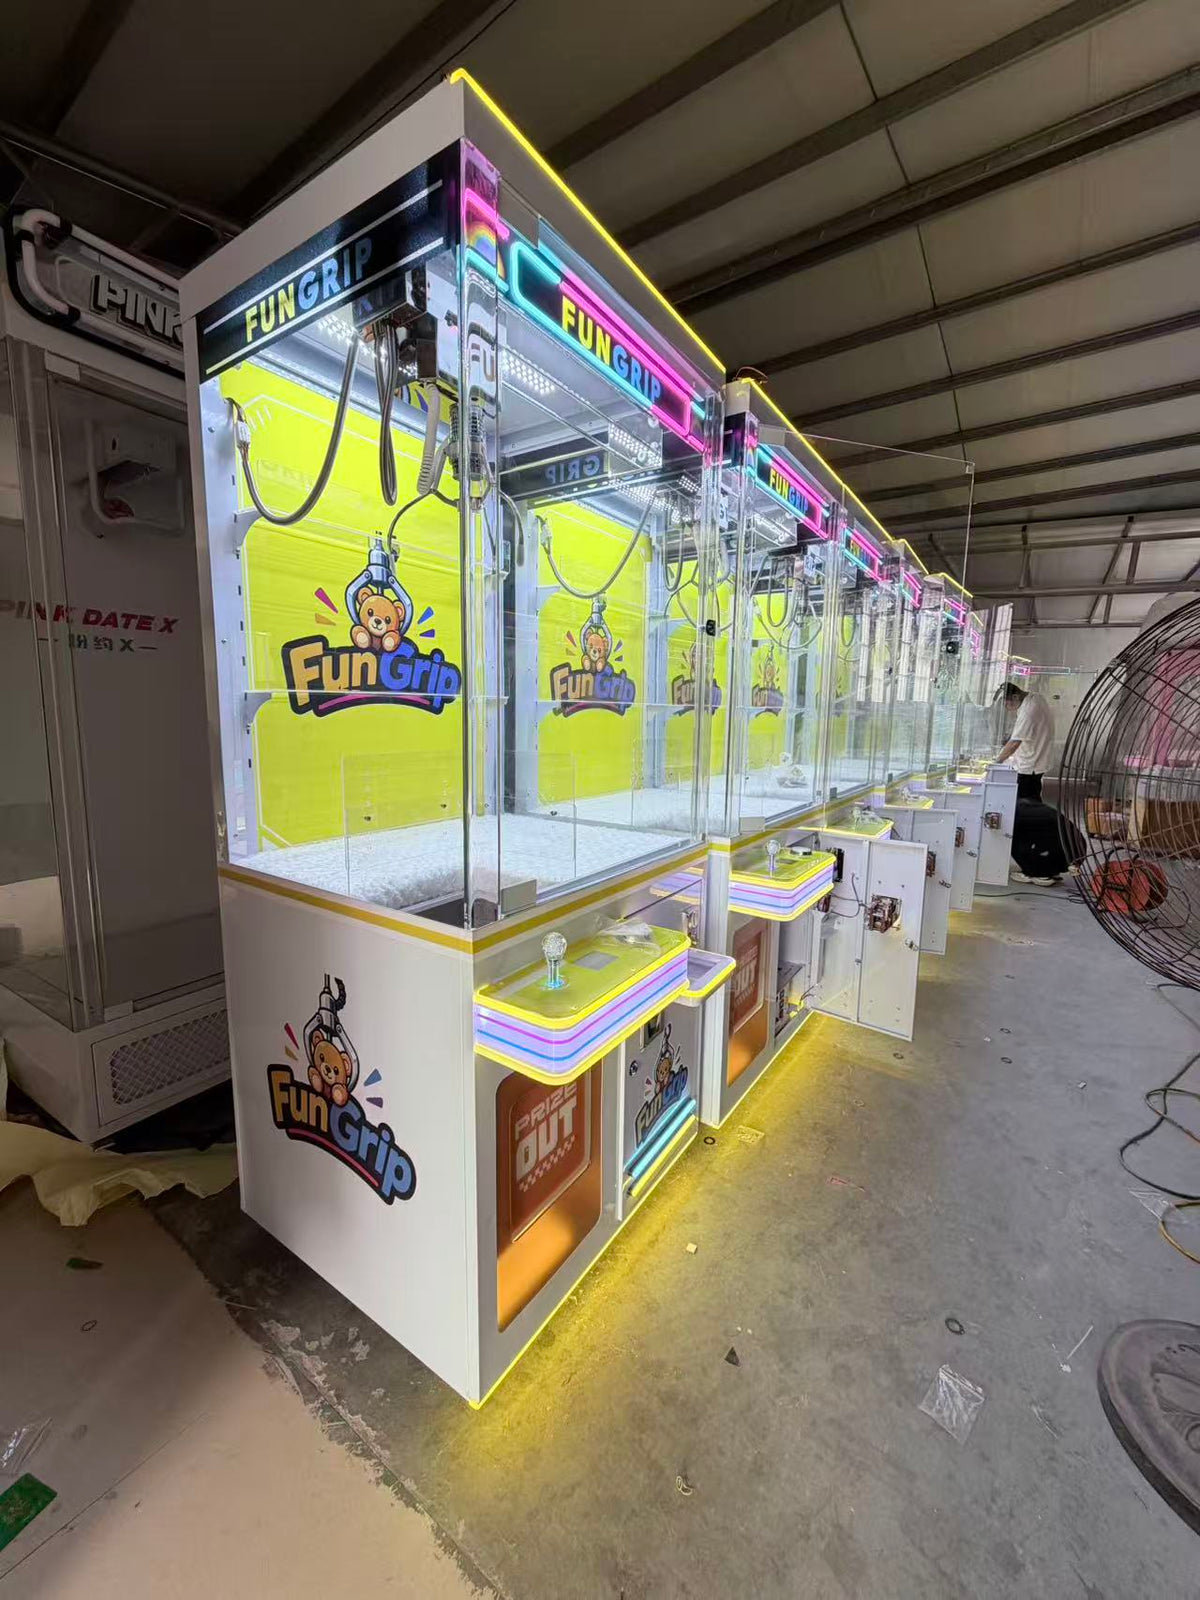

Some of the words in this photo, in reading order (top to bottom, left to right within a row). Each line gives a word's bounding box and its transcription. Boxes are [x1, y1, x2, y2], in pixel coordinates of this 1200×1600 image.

[93, 274, 183, 346] PINK
[82, 608, 155, 631] DATE
[158, 618, 179, 634] X
[284, 636, 461, 711] FunGrip
[269, 1066, 414, 1200] FunGrip
[514, 1082, 578, 1141] PRIZE
[515, 1095, 578, 1183] OUT
